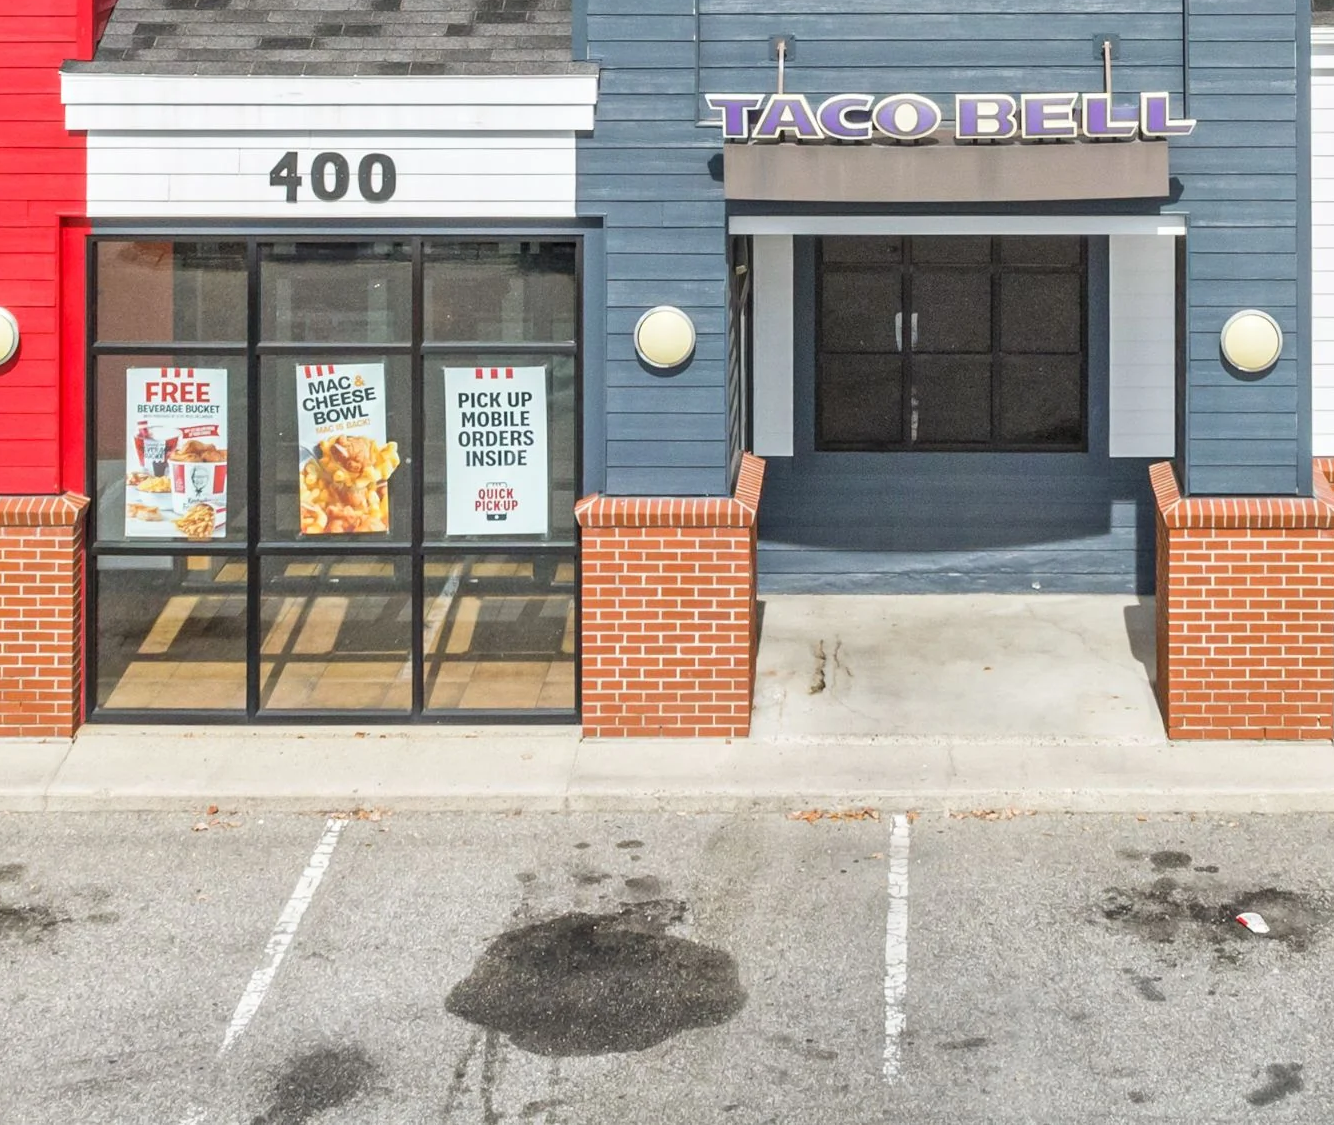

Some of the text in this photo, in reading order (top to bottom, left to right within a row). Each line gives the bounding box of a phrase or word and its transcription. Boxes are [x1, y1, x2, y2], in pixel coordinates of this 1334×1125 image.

[705, 92, 1197, 140] TACO BELL
[269, 151, 397, 204] 400
[145, 382, 210, 403] FREE
[308, 375, 365, 395] MAC &
[137, 404, 220, 413] BEVERAGE BUCKET
[303, 387, 376, 411] CHEESE
[458, 392, 533, 408] PICK UP
[313, 405, 369, 425] BOWL
[461, 411, 530, 427] MOBILE
[458, 430, 534, 447] ORDERS
[466, 449, 527, 467] INSIDE
[478, 488, 514, 500] QUICK
